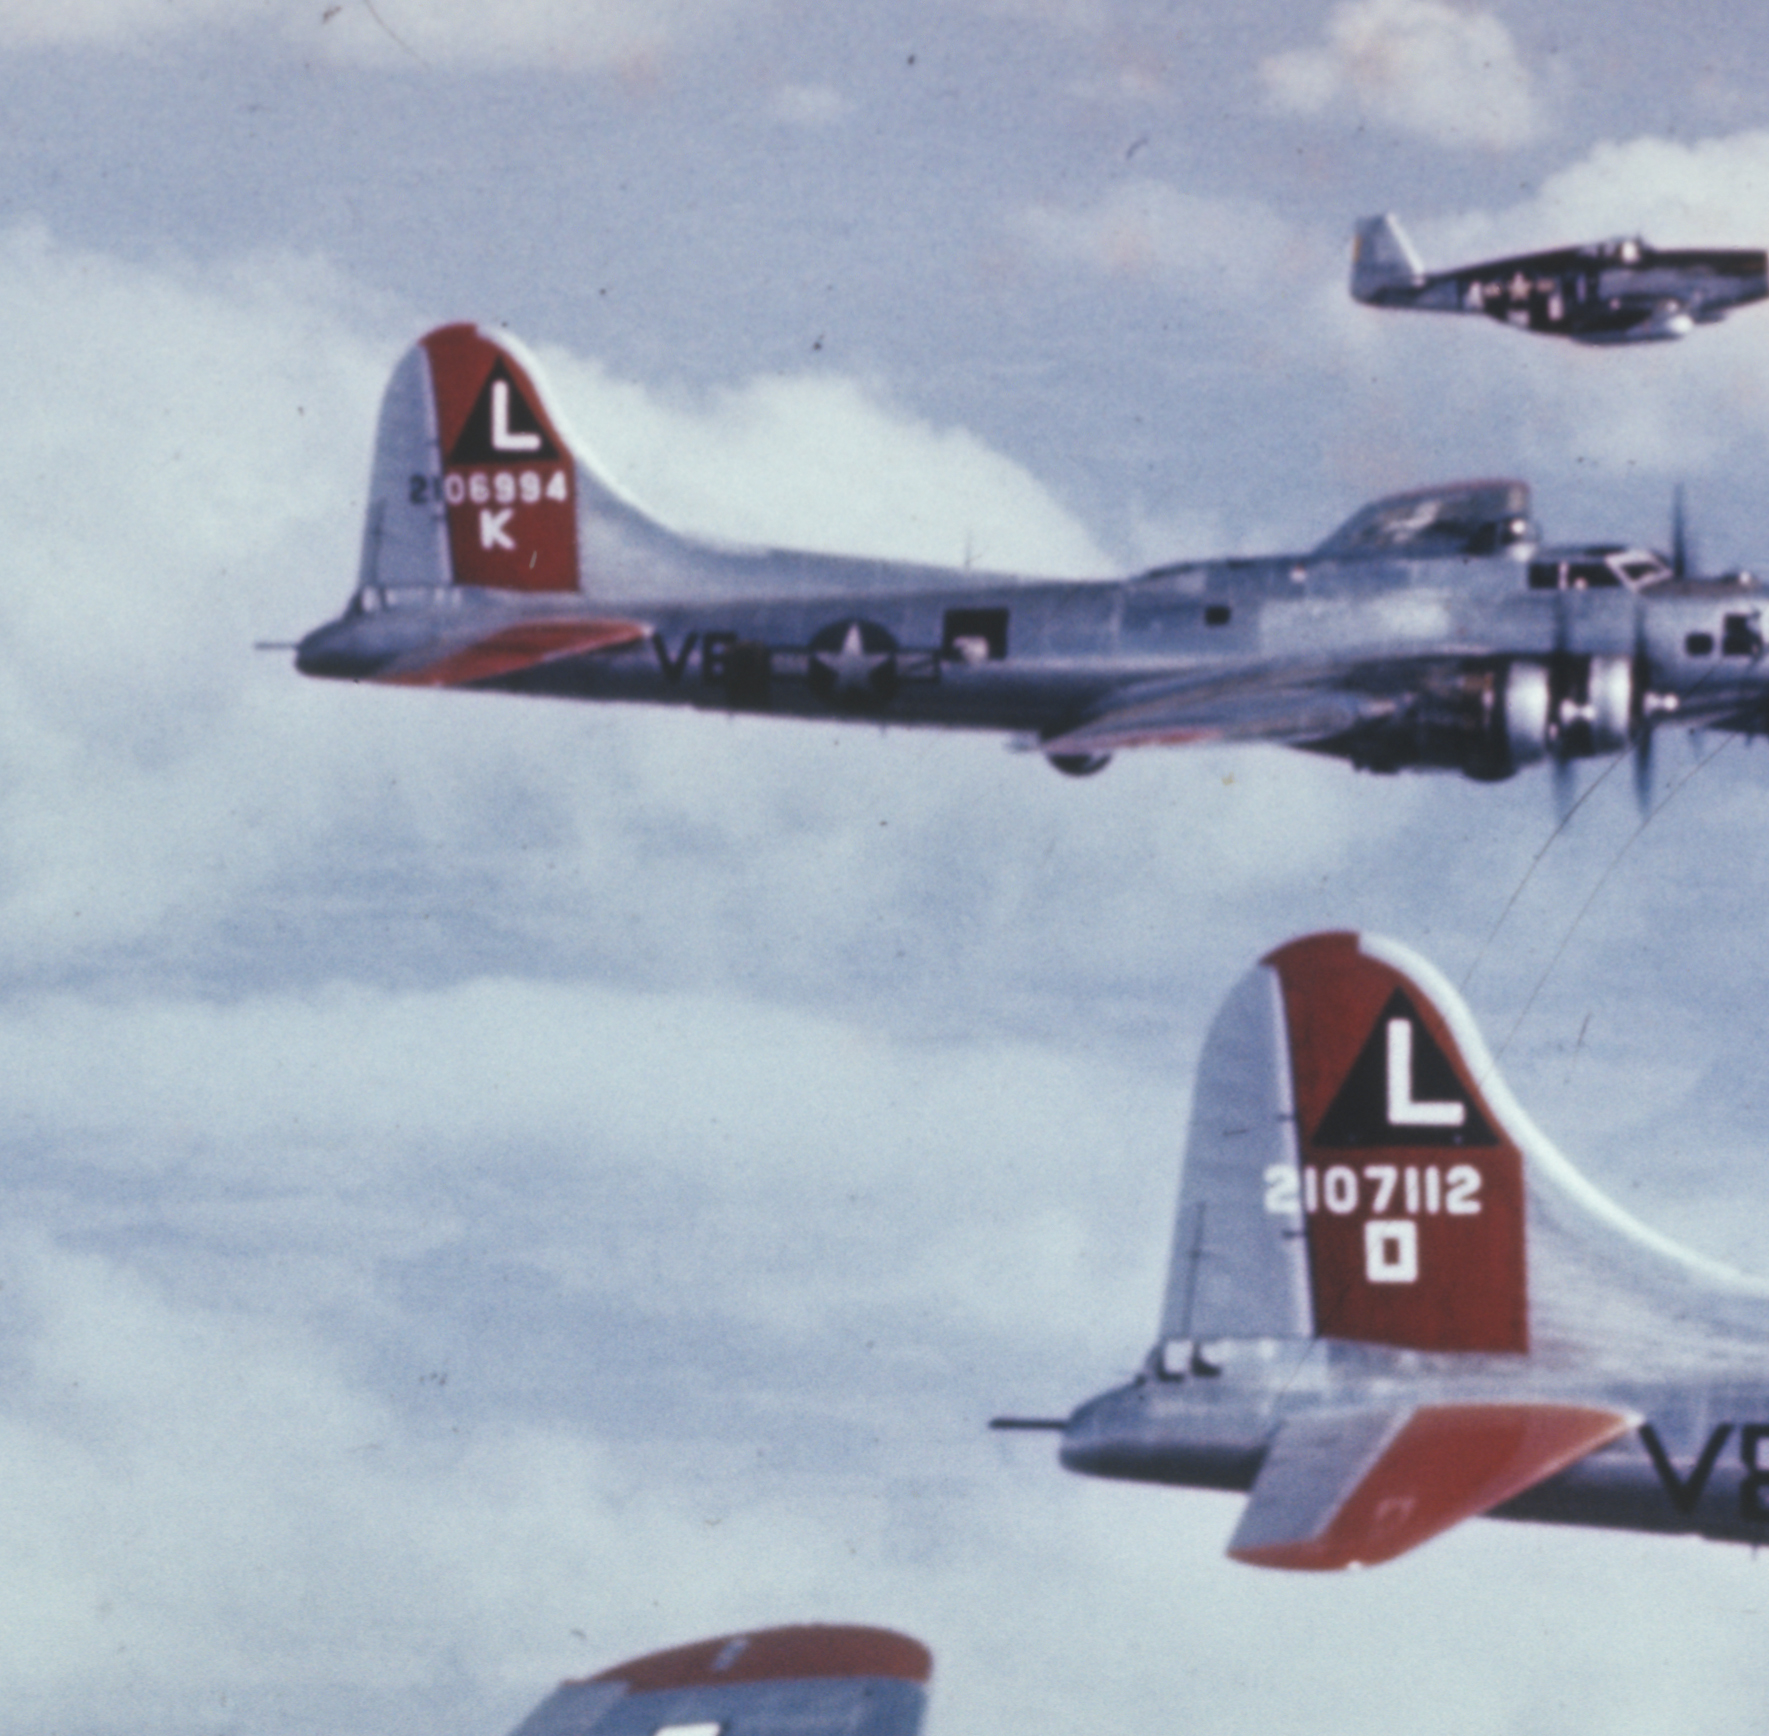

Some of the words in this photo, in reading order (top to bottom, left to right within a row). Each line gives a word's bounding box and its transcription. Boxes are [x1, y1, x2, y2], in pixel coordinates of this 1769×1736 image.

[491, 379, 541, 452] L
[479, 507, 518, 551] K
[1387, 1018, 1466, 1126] L
[1263, 1164, 1482, 1215] 2107112
